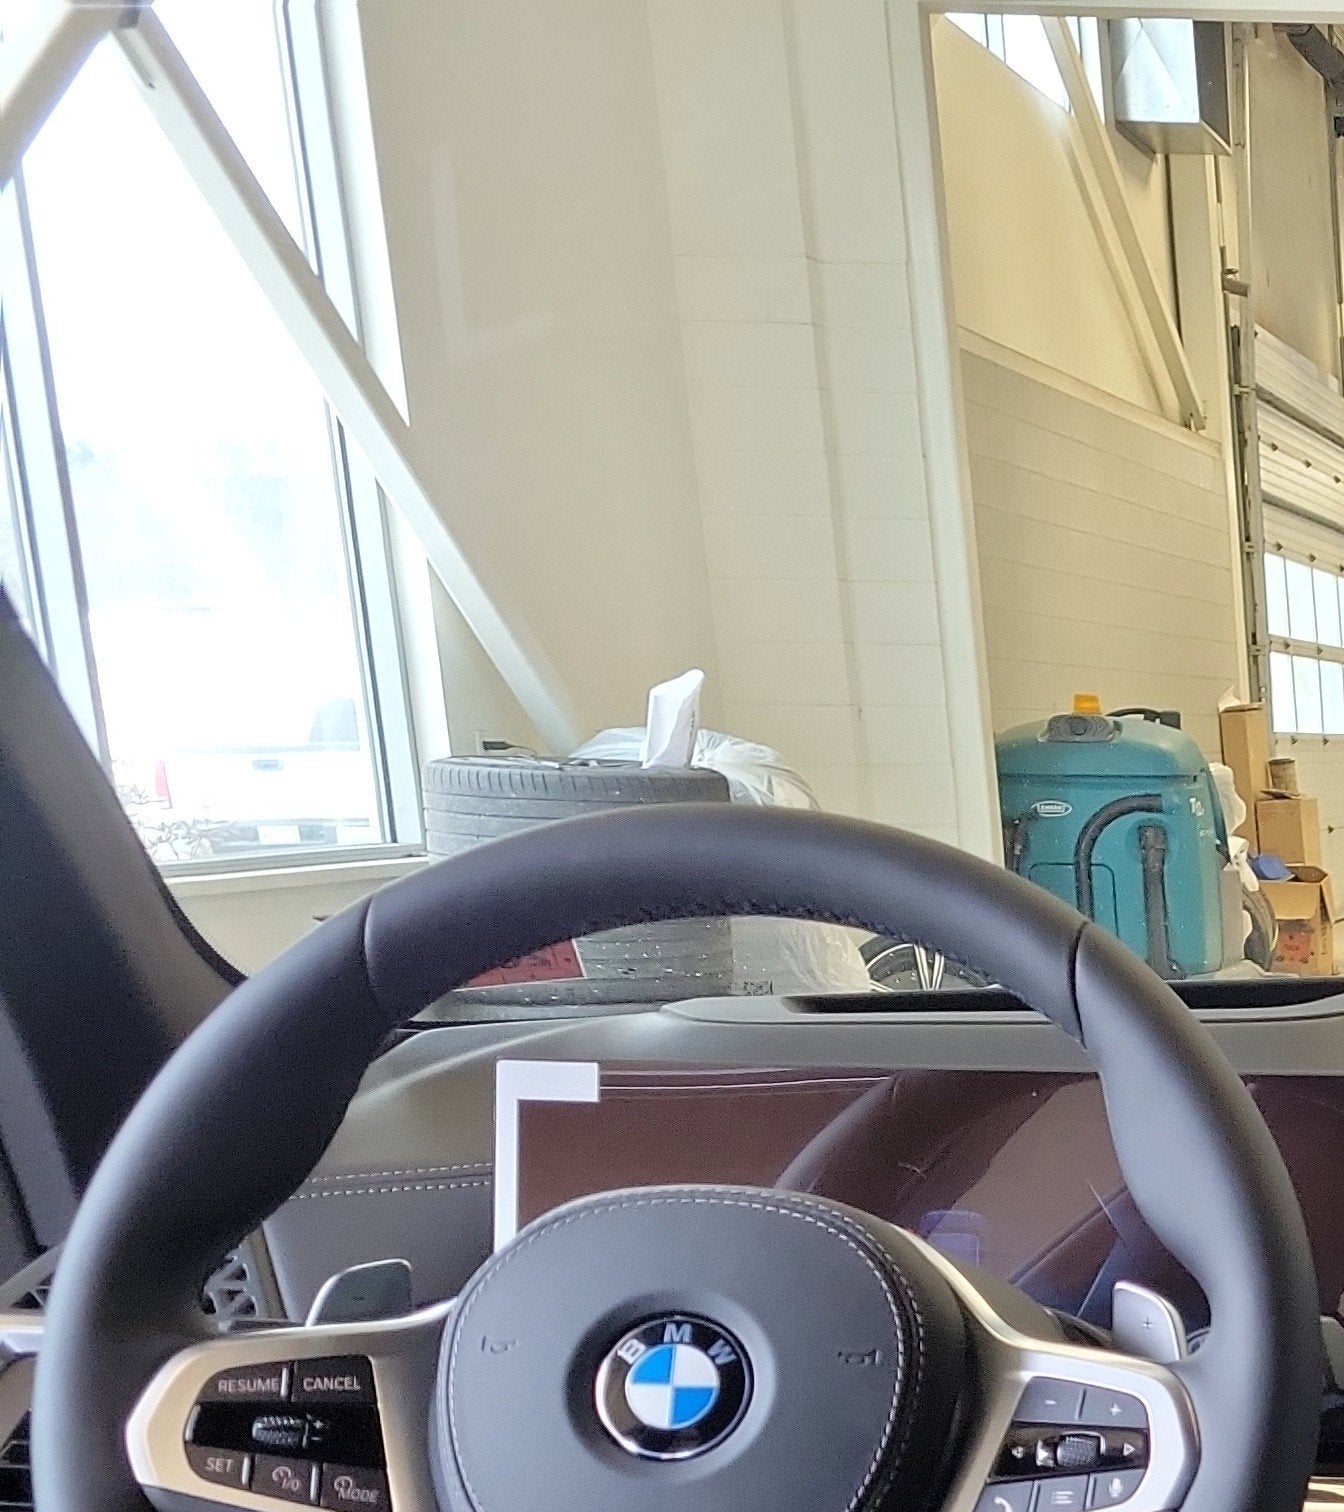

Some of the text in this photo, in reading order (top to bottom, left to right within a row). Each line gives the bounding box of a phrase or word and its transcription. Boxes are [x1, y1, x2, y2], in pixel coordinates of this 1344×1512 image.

[617, 1322, 738, 1365] BMW
[217, 1374, 361, 1394] RESUME CANCEL
[205, 1456, 234, 1473] SET
[337, 1486, 379, 1504] MODE
